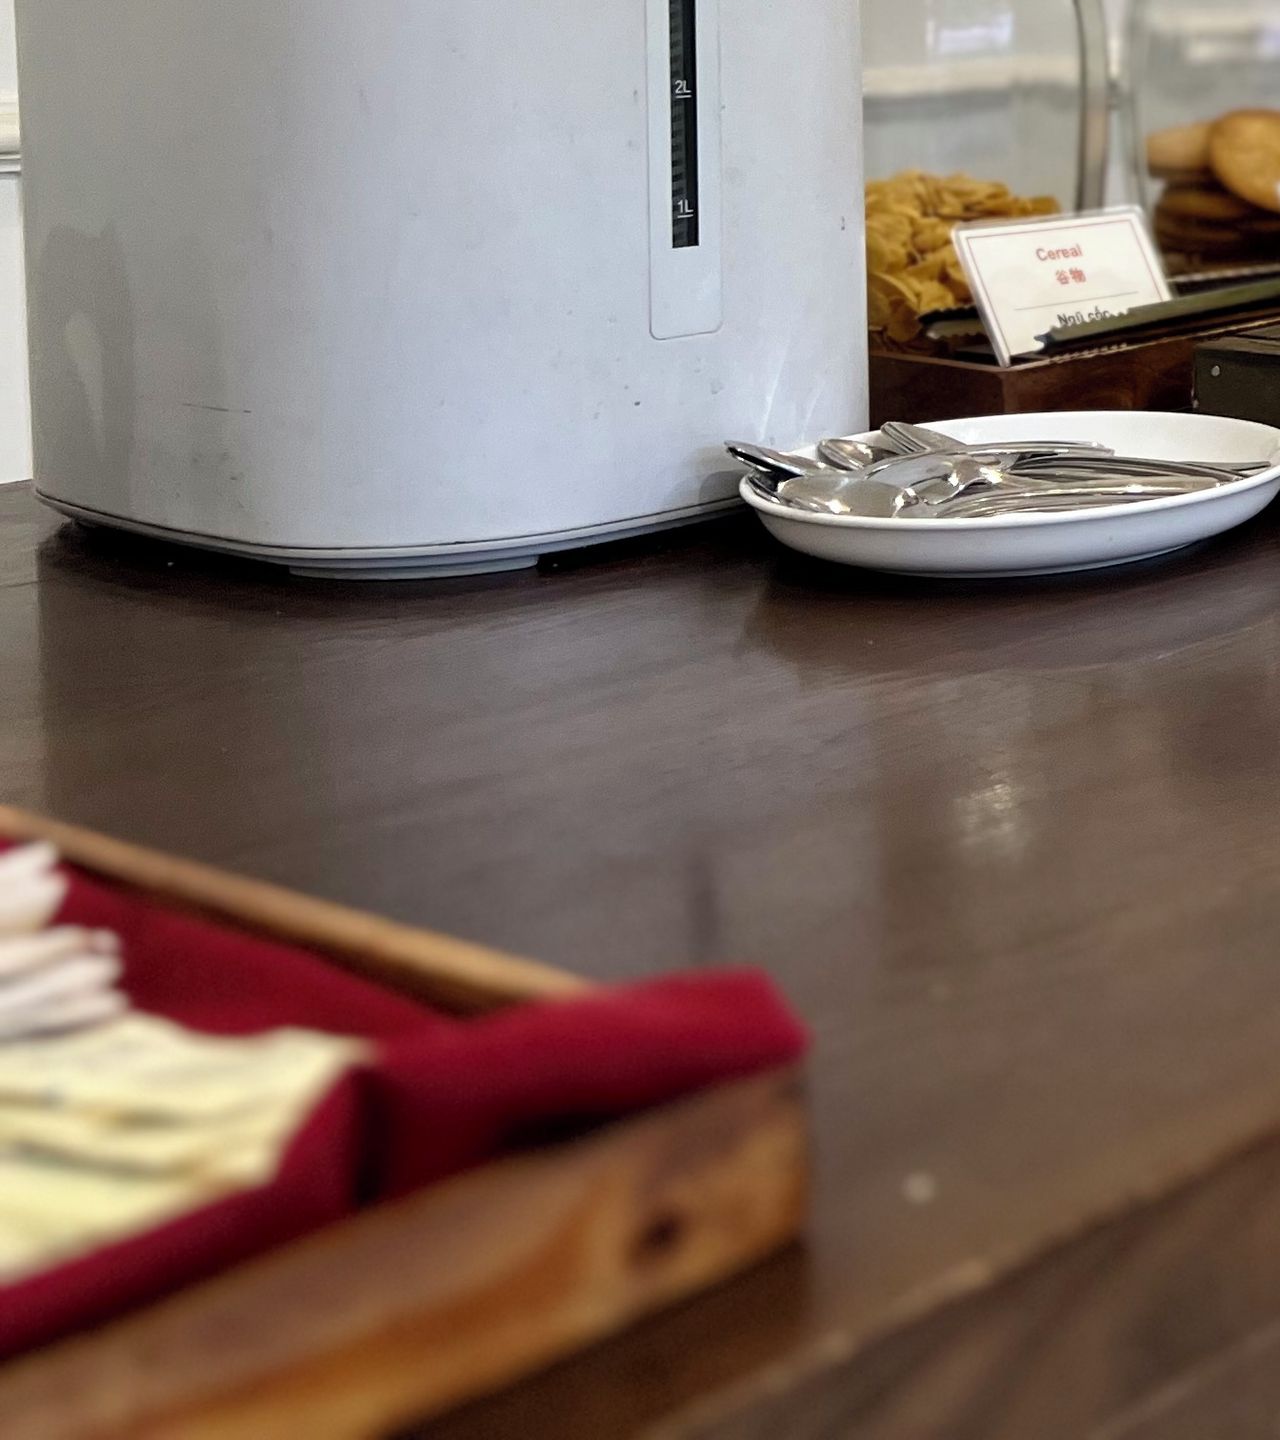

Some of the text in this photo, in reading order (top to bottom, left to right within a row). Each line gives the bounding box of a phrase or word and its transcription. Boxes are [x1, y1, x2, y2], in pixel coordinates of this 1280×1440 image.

[674, 80, 692, 95] 2L
[677, 199, 693, 214] 1L
[1035, 243, 1083, 262] Cereal
